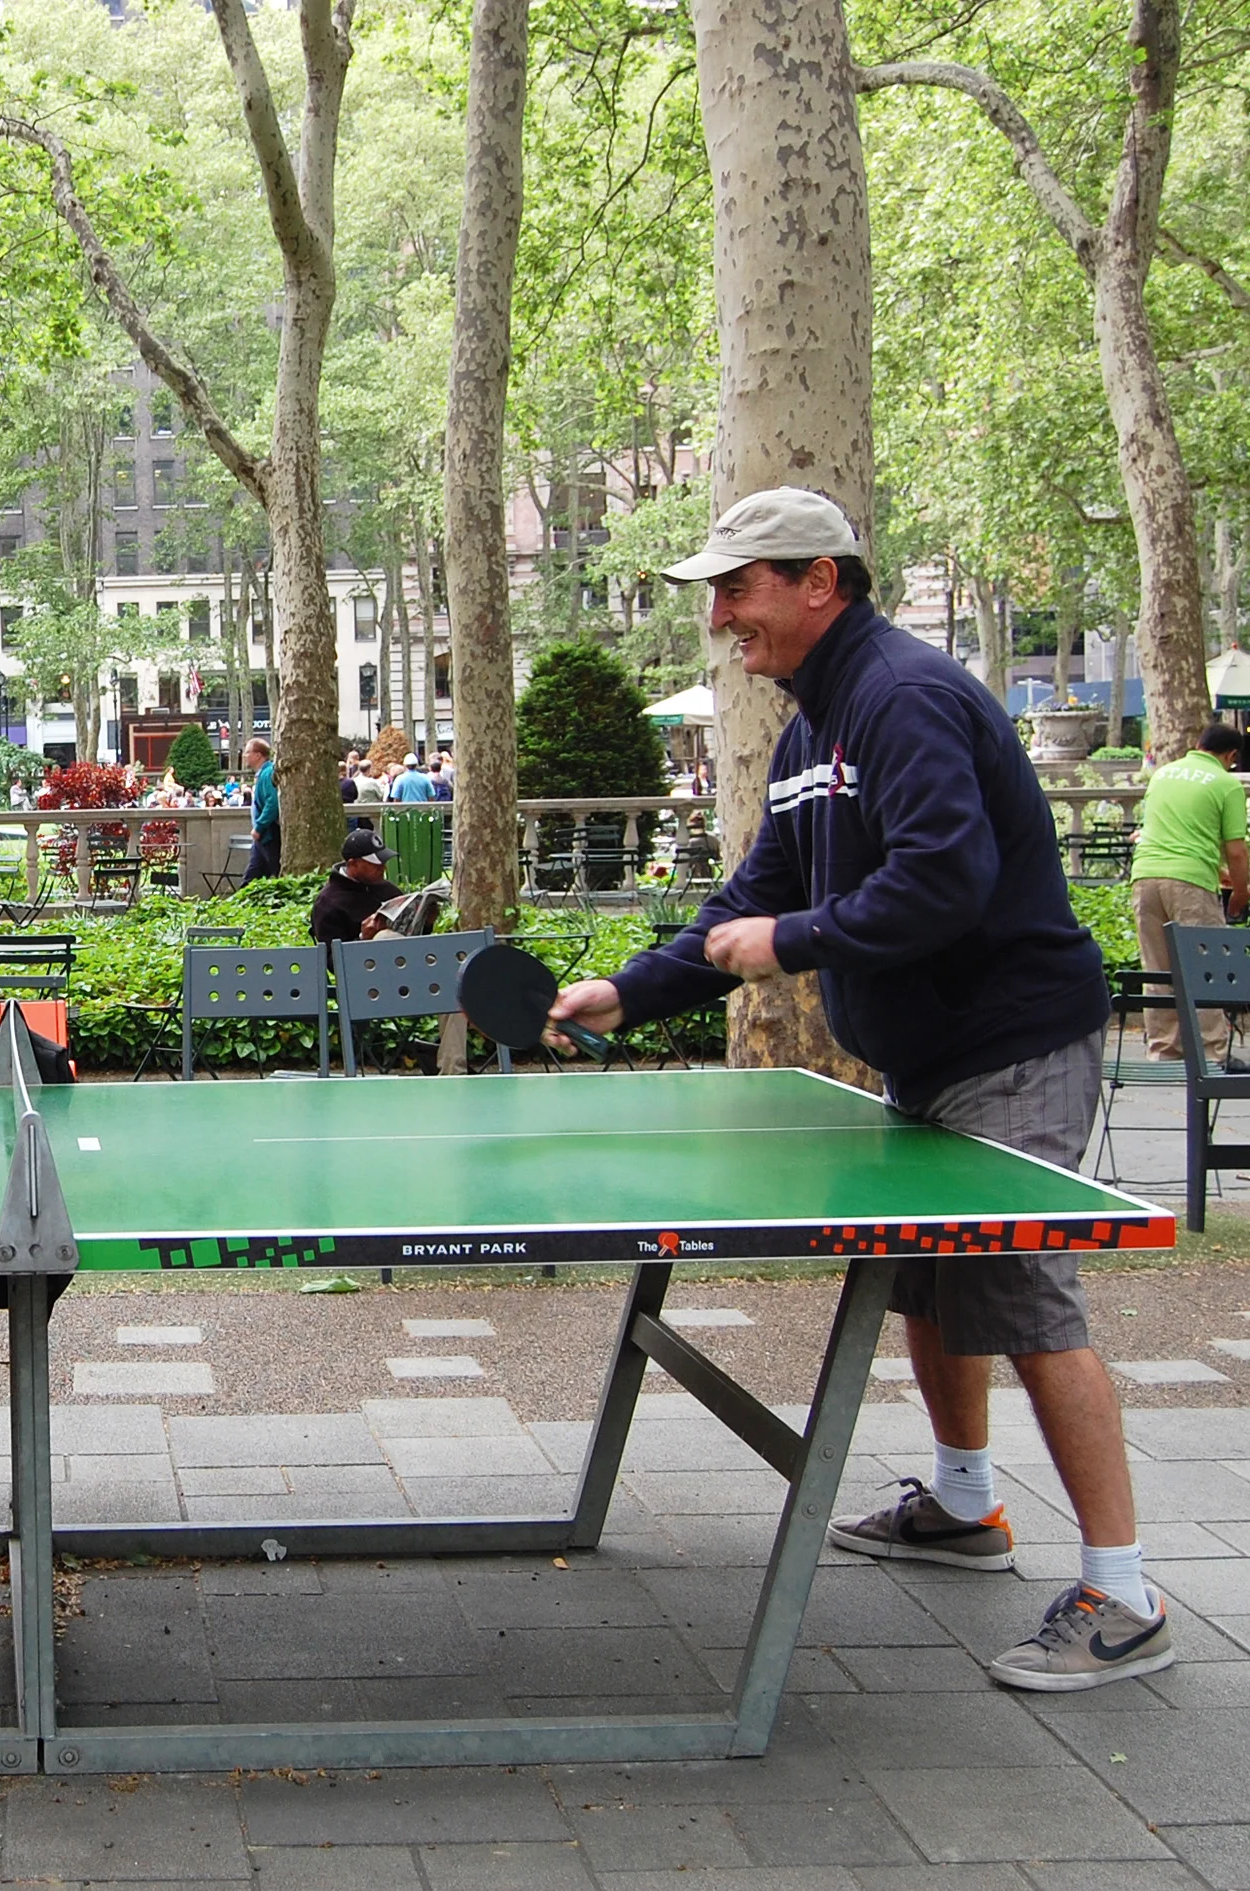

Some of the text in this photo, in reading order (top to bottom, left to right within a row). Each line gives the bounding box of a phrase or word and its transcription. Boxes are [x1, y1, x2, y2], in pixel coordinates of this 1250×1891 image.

[1157, 765, 1217, 785] STAFF
[402, 1242, 527, 1256] BRYANT PARK
[637, 1240, 715, 1252] The Tables
